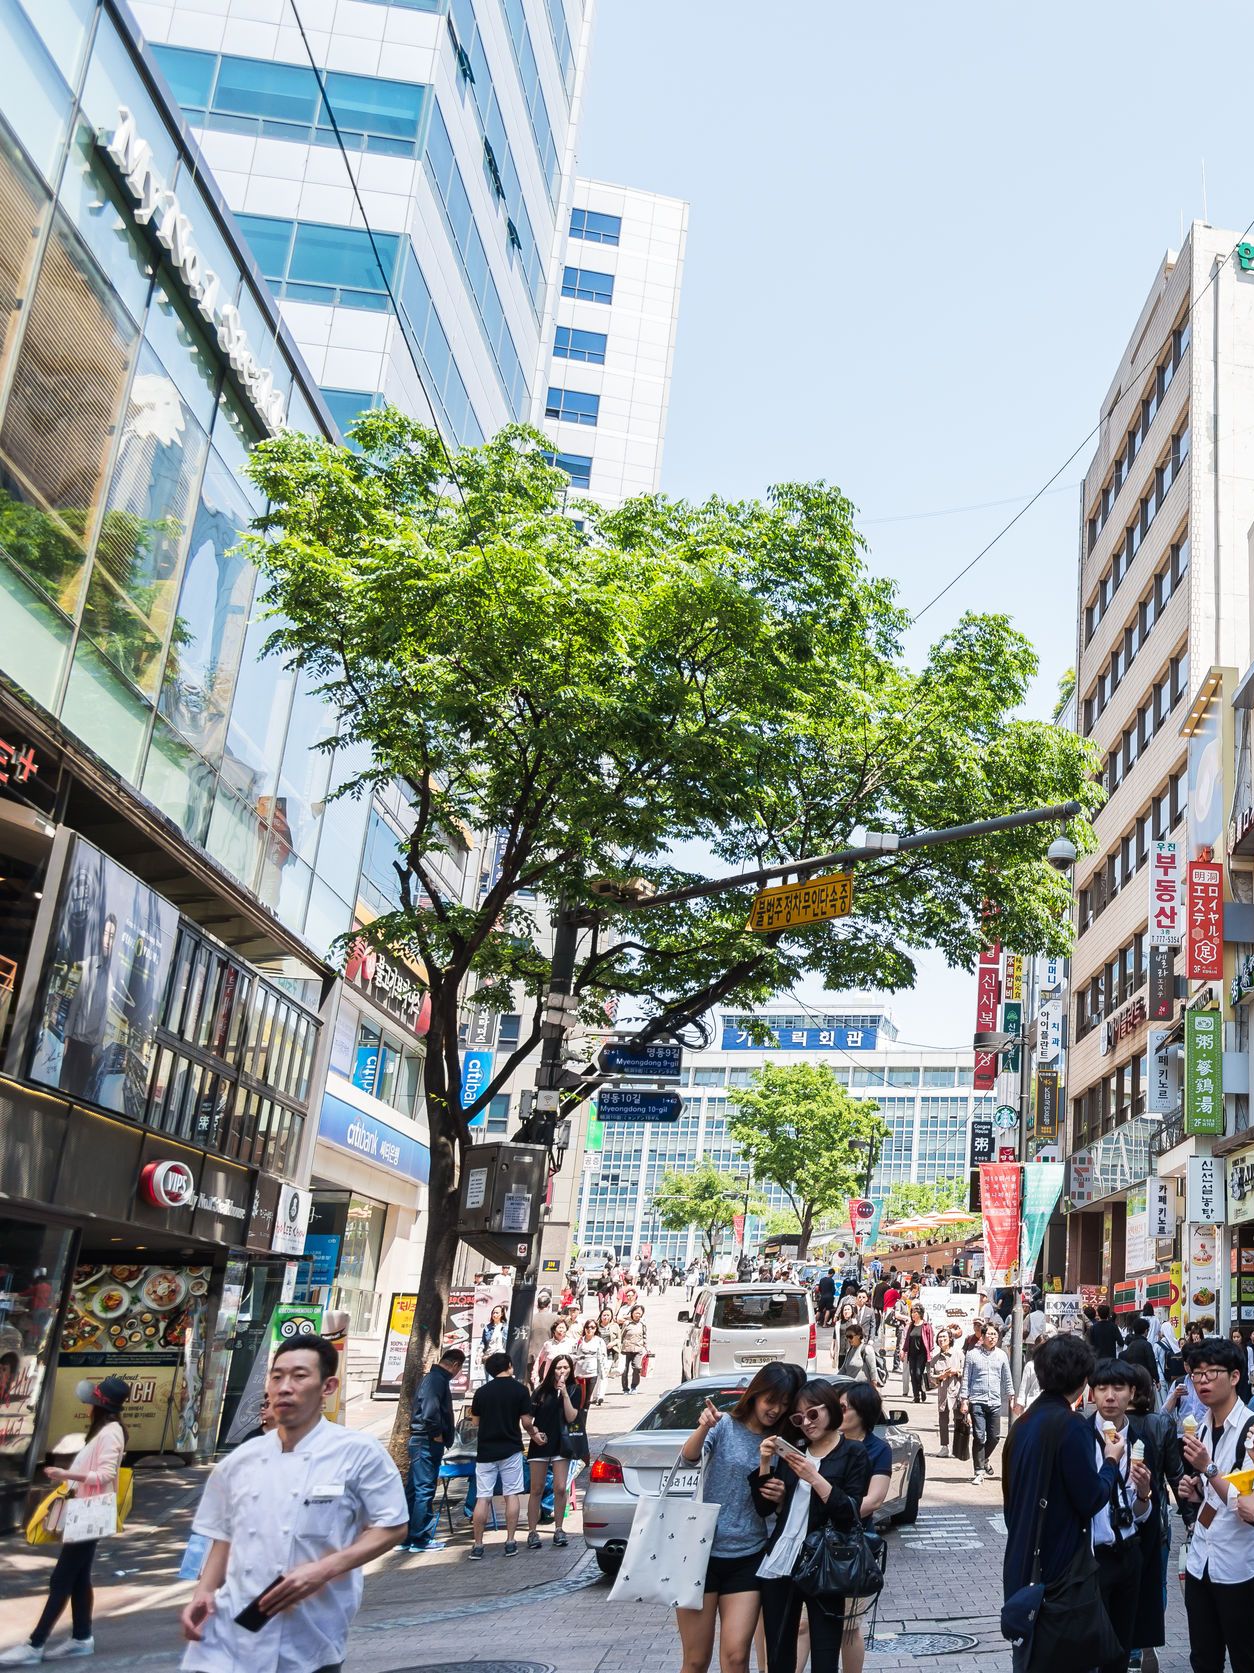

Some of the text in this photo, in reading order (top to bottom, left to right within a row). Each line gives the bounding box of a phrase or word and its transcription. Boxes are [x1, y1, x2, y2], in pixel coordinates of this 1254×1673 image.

[1154, 852, 1178, 930] 부동산
[1193, 886, 1206, 926] エステ
[1040, 1011, 1050, 1059] 아이플란트
[1051, 1022, 1060, 1048] 치과
[616, 1058, 662, 1067] Myeongdong
[647, 1048, 680, 1059] 명동9길
[1157, 1069, 1169, 1099] 키노르
[600, 1105, 668, 1113] Myeongdong 10-gil
[601, 1093, 641, 1105] 명동10길
[346, 1118, 379, 1155] citibank
[974, 1137, 989, 1152] 粥
[165, 1170, 188, 1194] VIPS
[1200, 1159, 1215, 1220] 신선설농탕
[1158, 1184, 1168, 1235] 카페 키노르
